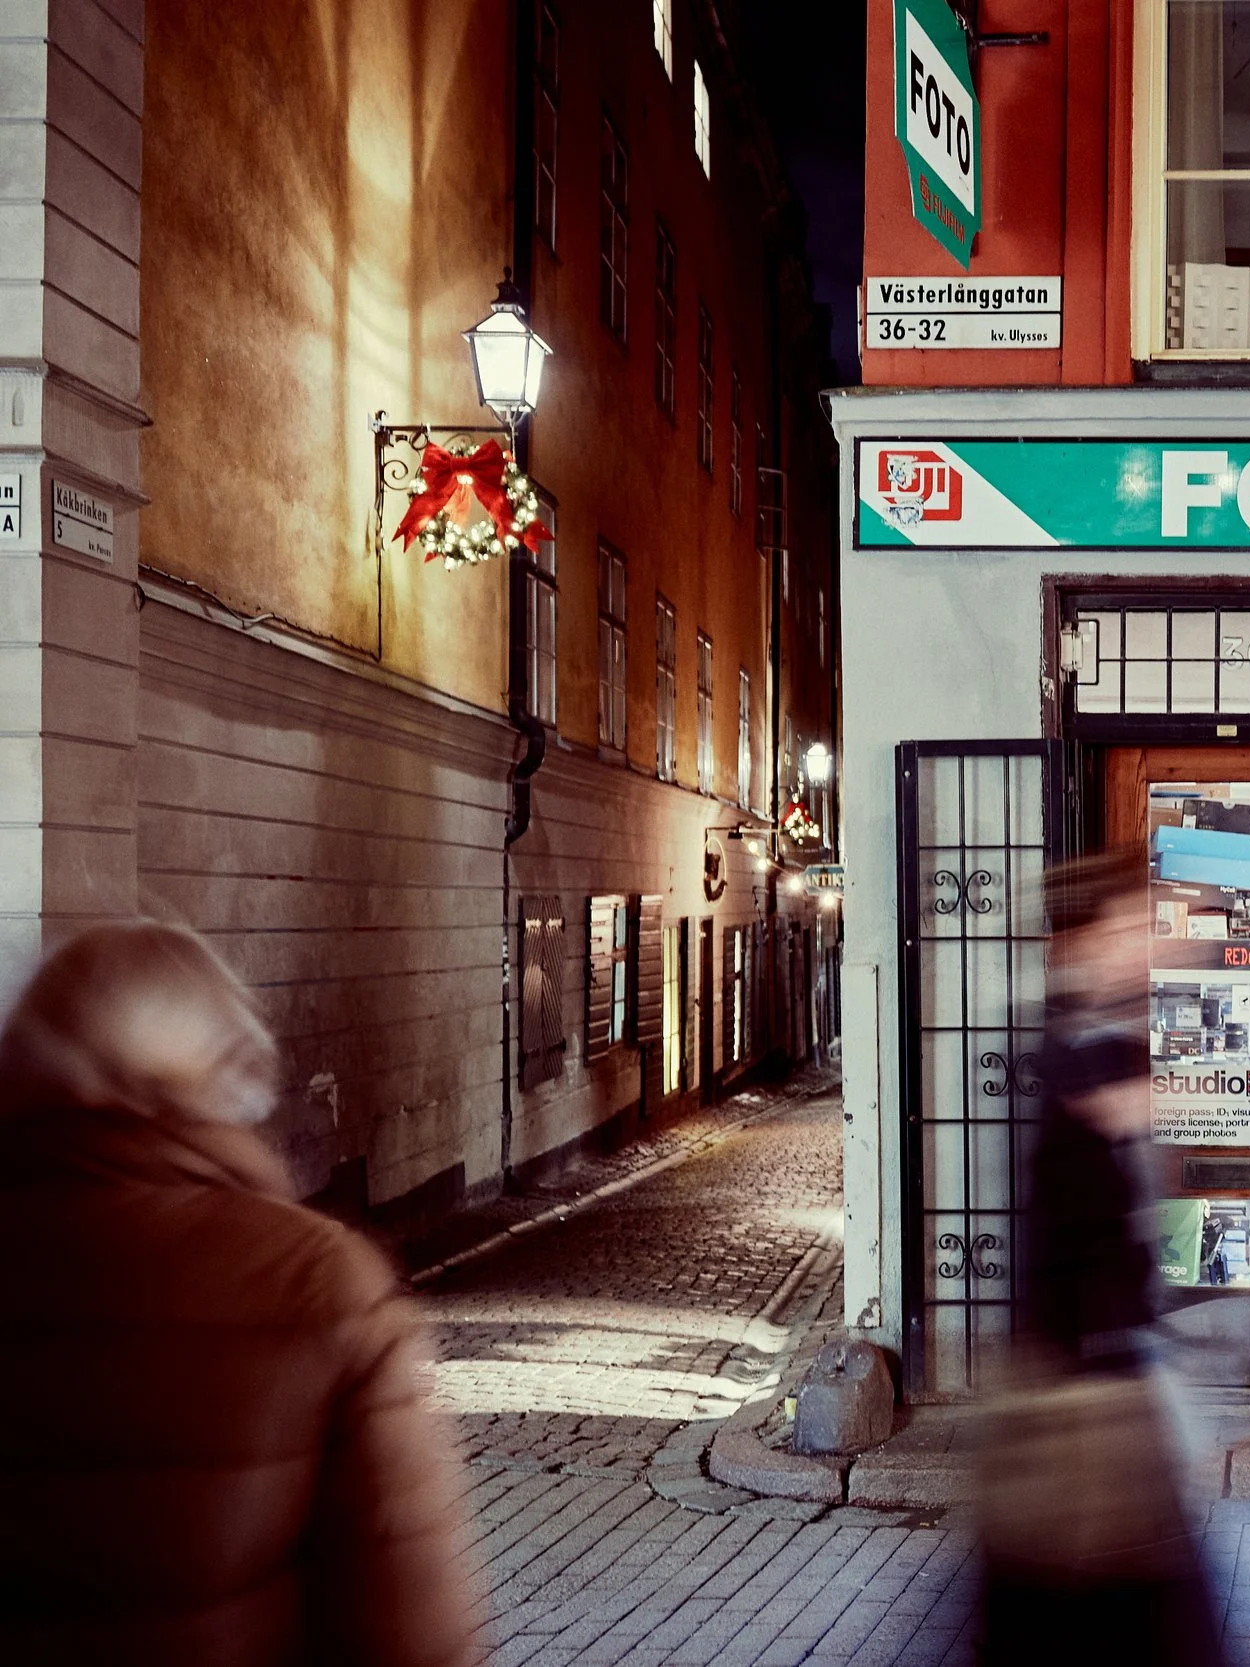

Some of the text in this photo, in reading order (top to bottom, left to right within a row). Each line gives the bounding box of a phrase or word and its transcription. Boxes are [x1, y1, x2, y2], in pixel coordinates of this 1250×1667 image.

[911, 50, 971, 176] FOTO
[880, 283, 1048, 309] Västerlånggatan
[879, 319, 947, 341] 36-32
[991, 329, 1007, 342] kv.
[57, 486, 107, 524] Kåkbrinken
[1152, 1070, 1246, 1095] studio
[1154, 1107, 1187, 1118] foreign
[1154, 1117, 1186, 1127] drivers
[1154, 1128, 1238, 1139] and group photos
